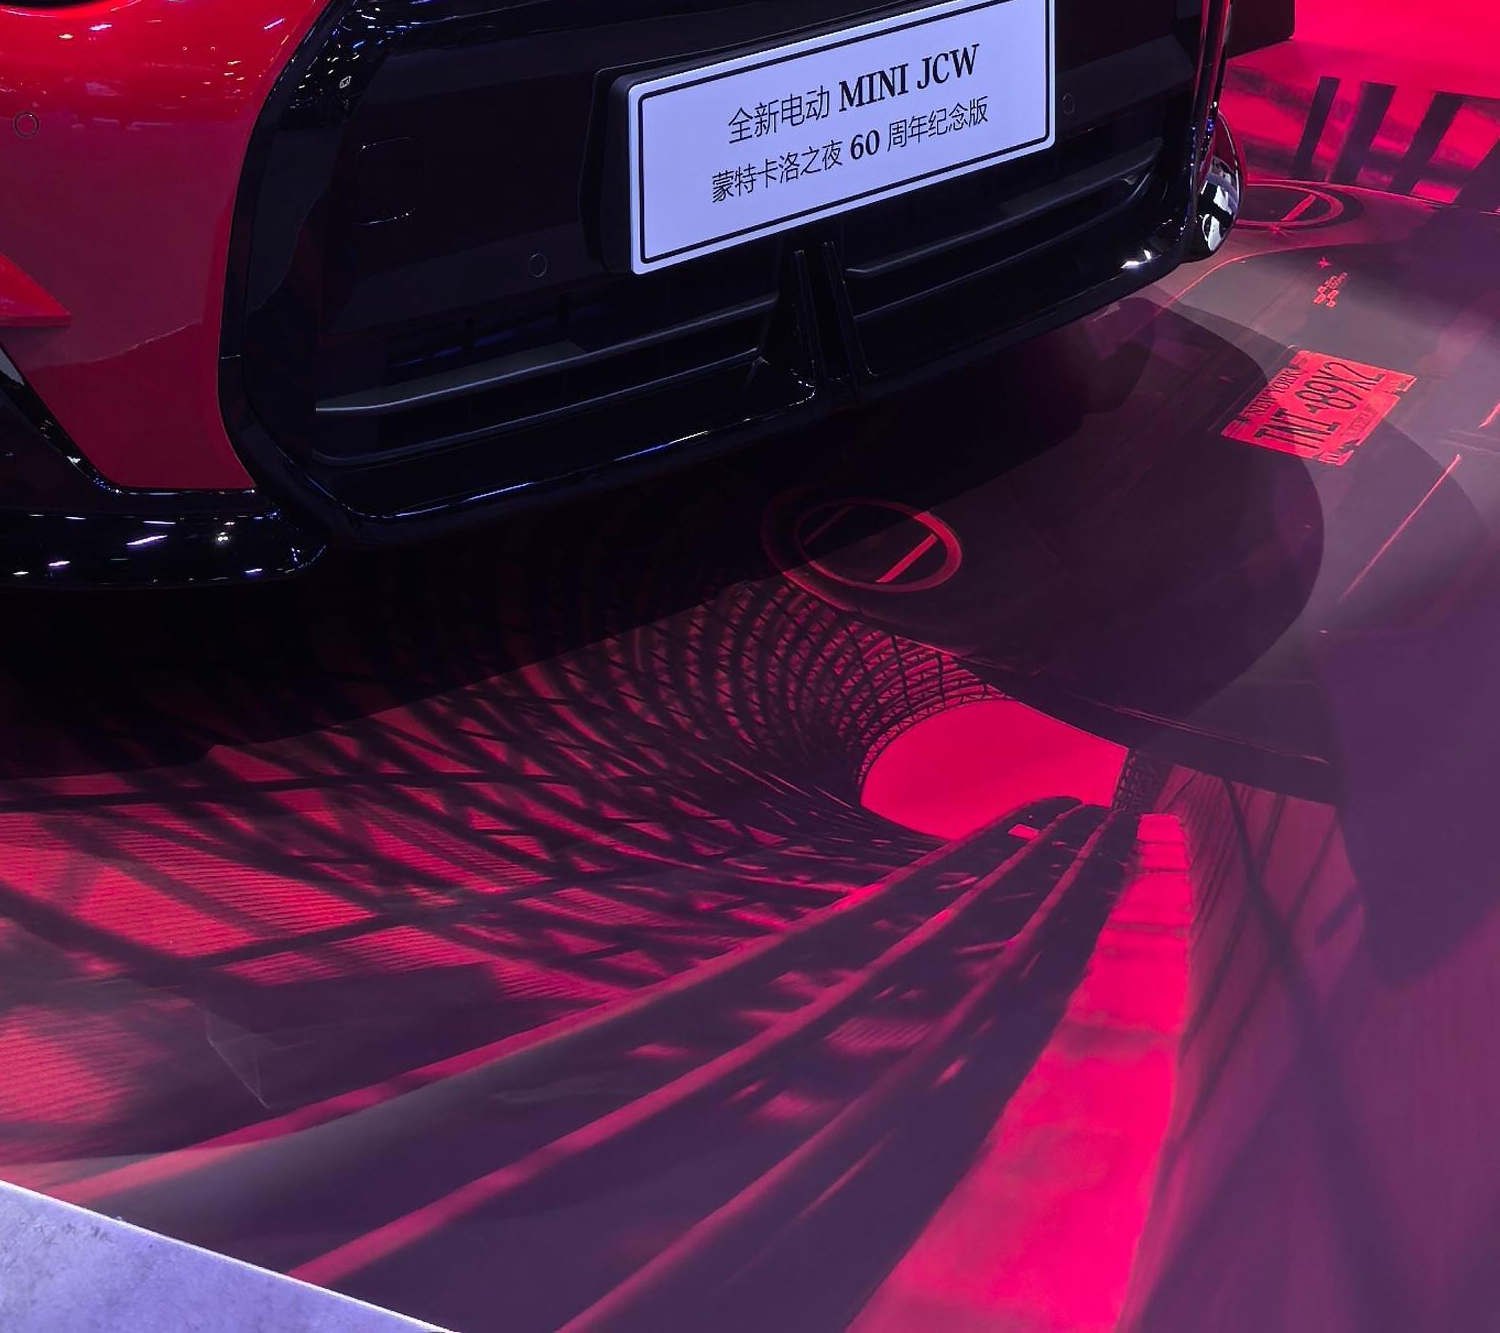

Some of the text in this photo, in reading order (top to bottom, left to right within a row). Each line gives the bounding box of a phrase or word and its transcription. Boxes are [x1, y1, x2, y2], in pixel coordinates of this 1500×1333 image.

[727, 42, 981, 145] 全新电动 MINI JCW
[711, 95, 990, 204] 蒙特卡洛之夜 60 周年纪念版
[1269, 368, 1303, 395] YORK
